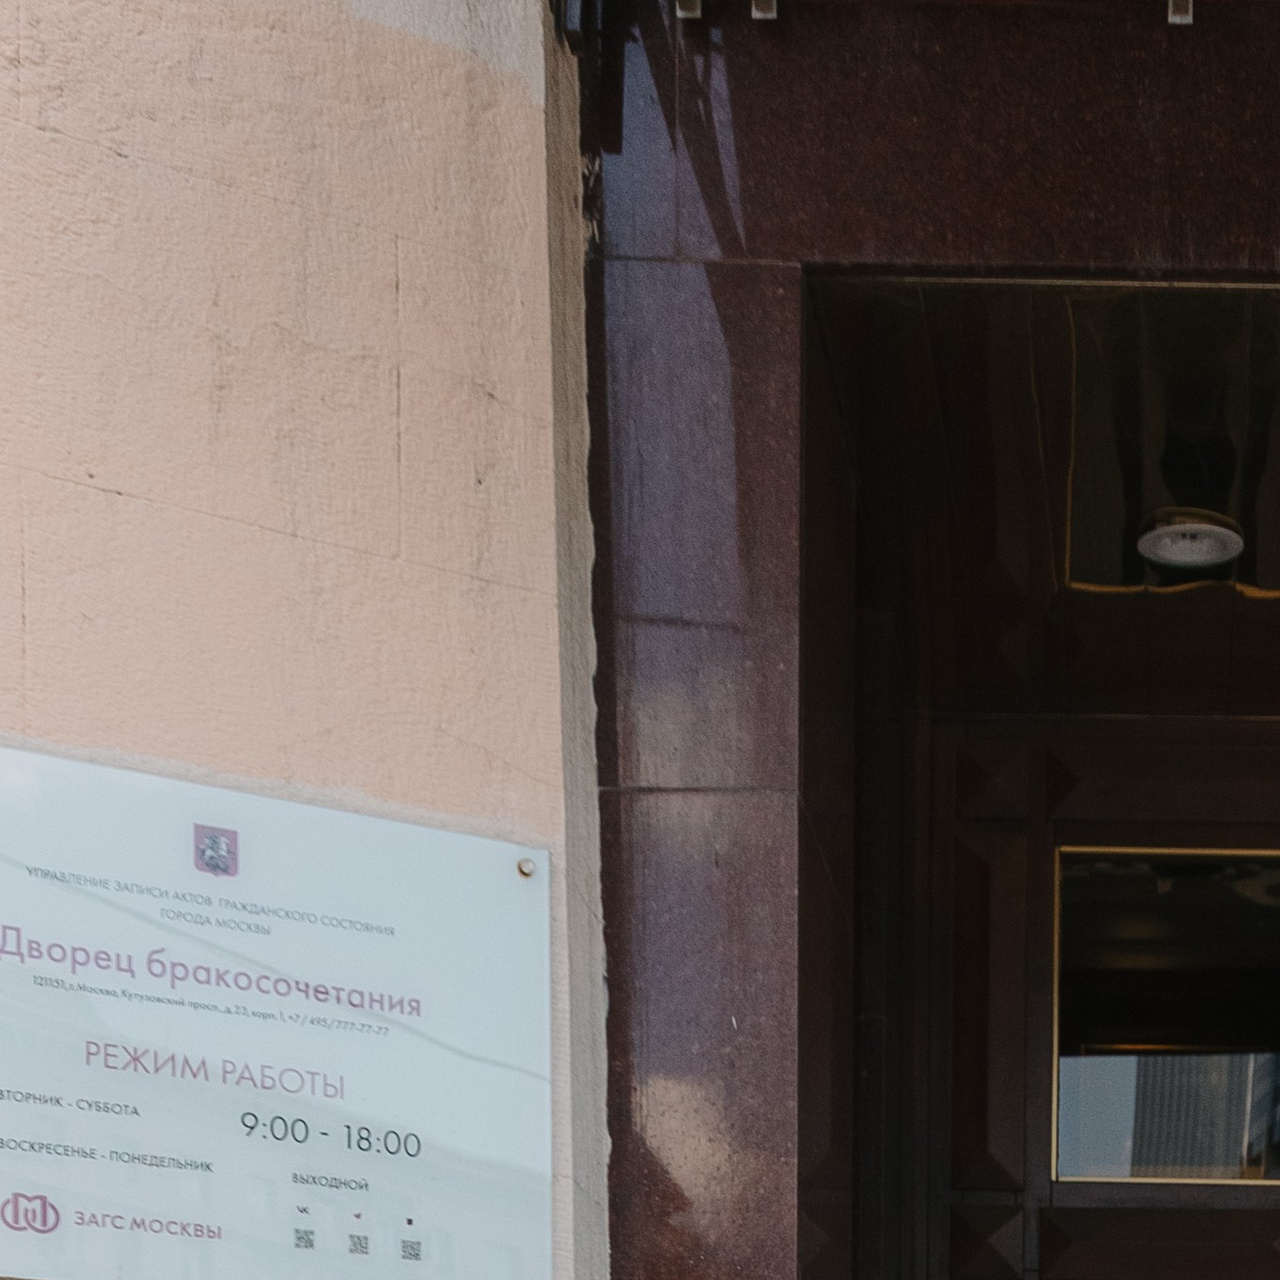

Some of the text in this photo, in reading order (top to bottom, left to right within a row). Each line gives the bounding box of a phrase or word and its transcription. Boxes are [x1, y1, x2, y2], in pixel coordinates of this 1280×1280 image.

[25, 865, 396, 936] УПРАВЛЕНИЕ ЗАПИСИ АКТОВ ГРАЖДАНСКОГО СОСТОЯНИЯ
[160, 907, 271, 936] ГОРОДА МОСКВЫ
[0, 924, 422, 1017] Дворец бракосочетания
[84, 1040, 345, 1100] РЕЖИМ РАБОТЫ
[75, 1098, 141, 1117] СУББОТА
[241, 1111, 310, 1144] 9:00
[343, 1124, 421, 1158] 18:00
[109, 1149, 214, 1173] ПОНЕДЕЛЬНИК
[291, 1171, 370, 1192] ВЫХОДНОЙ
[73, 1210, 223, 1240] ЗАГС МОСКВЫ
